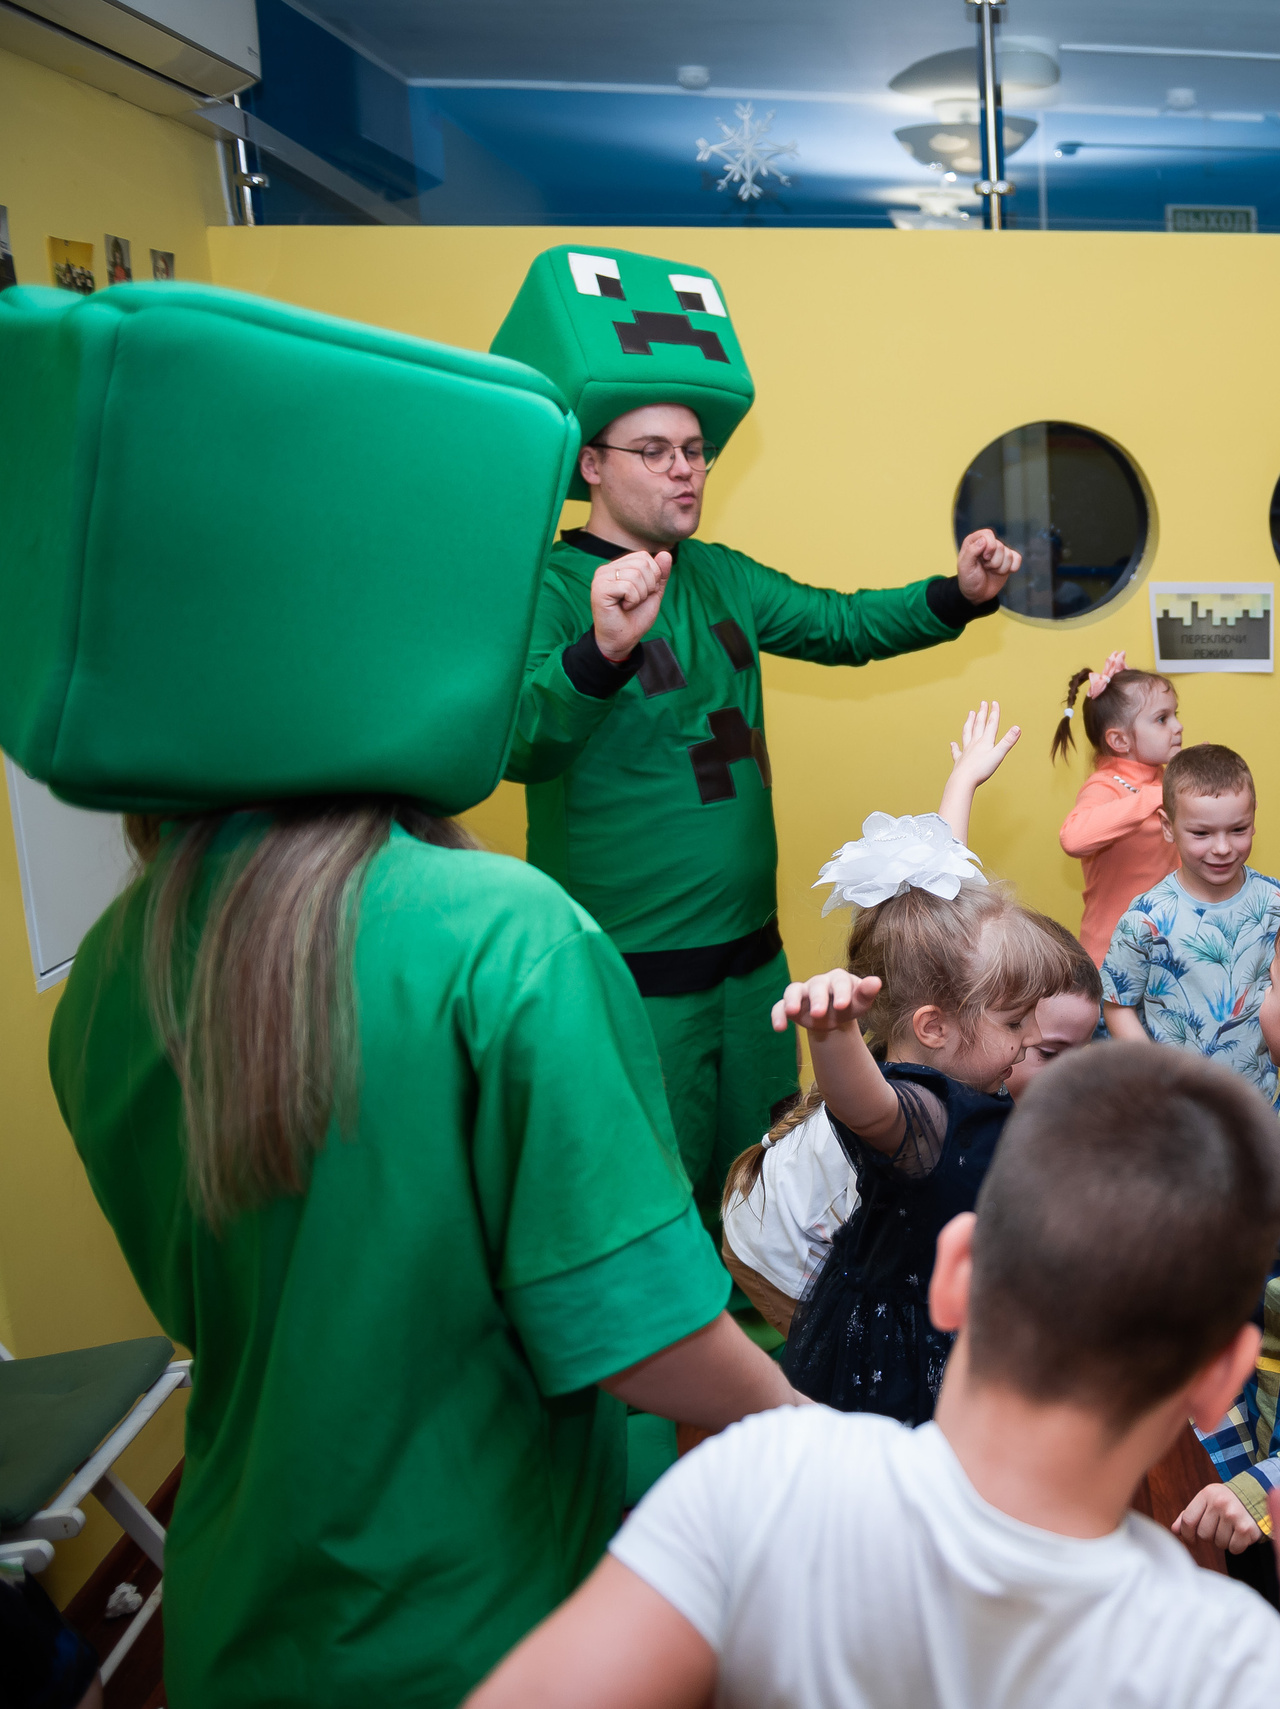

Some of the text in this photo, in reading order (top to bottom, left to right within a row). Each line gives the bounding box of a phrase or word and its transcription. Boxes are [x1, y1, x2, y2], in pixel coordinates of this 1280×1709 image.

[1175, 211, 1246, 230] ВЫХОД
[1181, 634, 1247, 645] ПЕРЕКЛЮЧИ
[1194, 649, 1233, 658] РЕЖИМ
